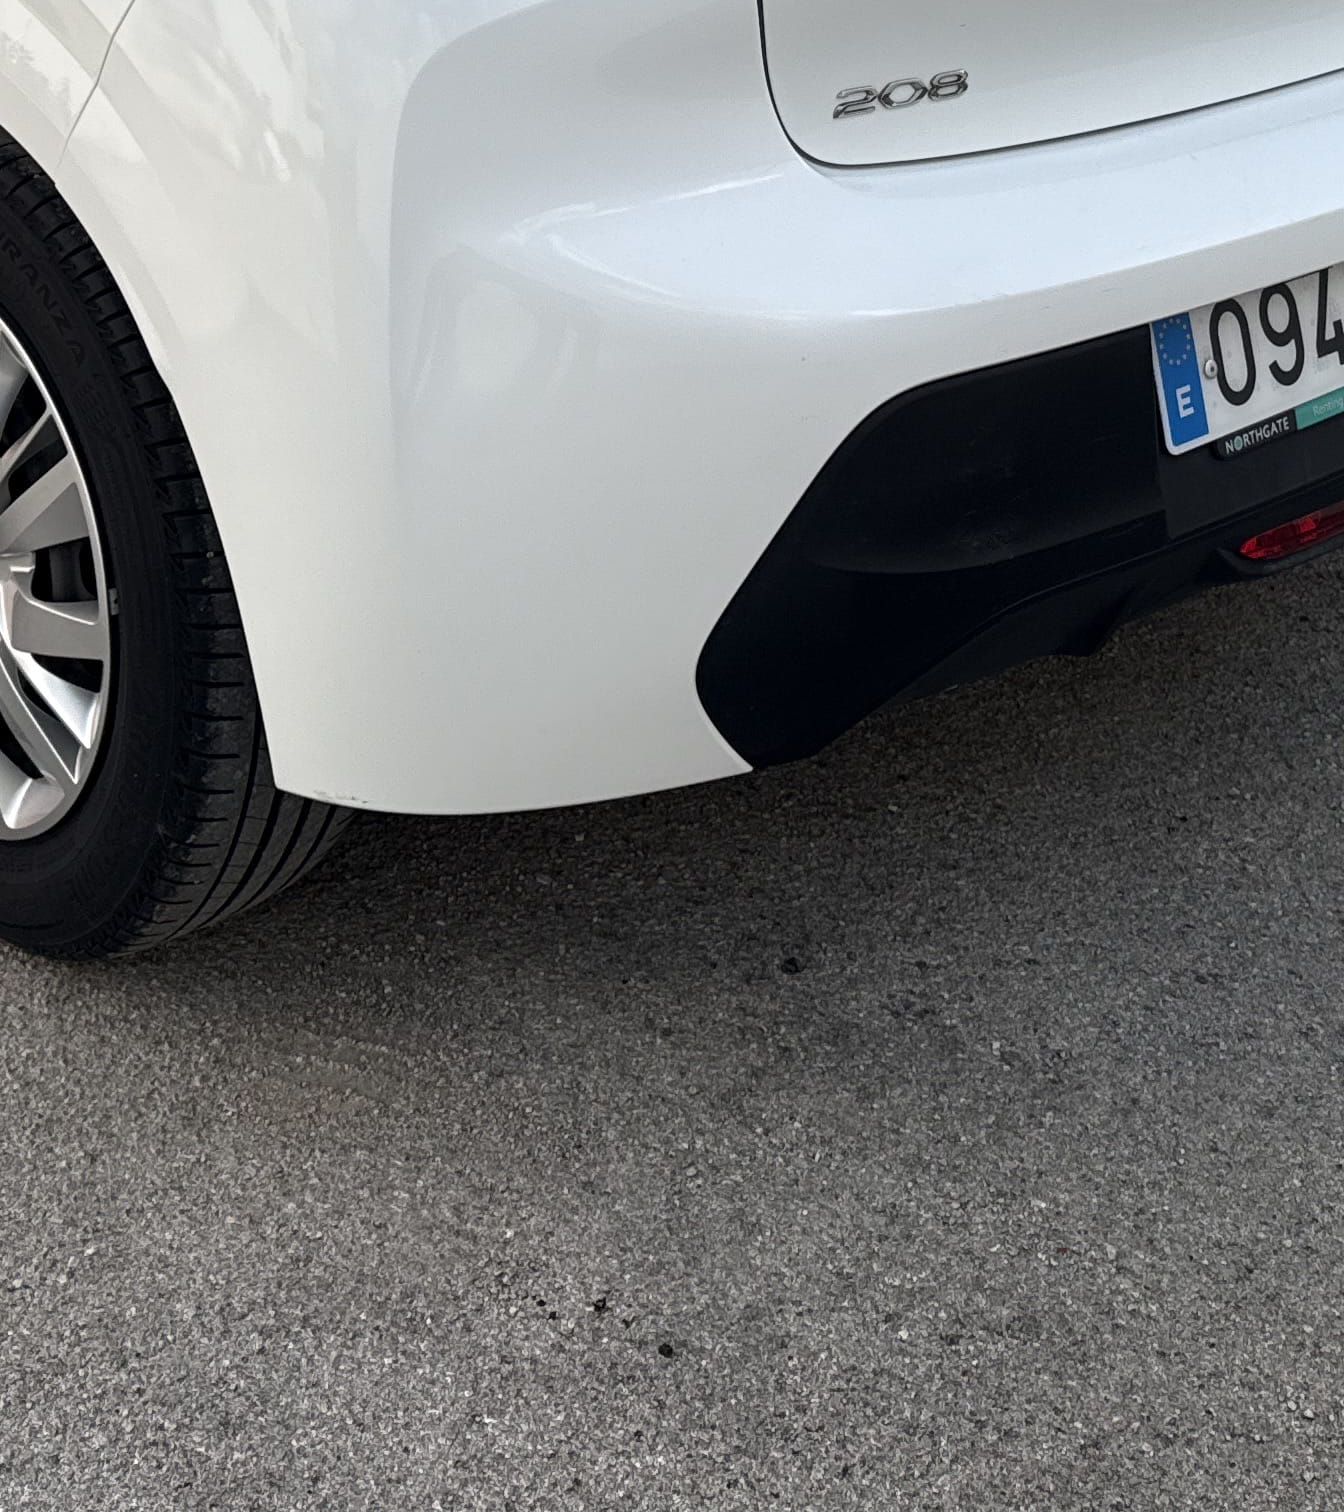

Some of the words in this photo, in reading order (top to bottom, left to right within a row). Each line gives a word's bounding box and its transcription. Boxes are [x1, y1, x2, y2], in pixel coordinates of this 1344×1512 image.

[833, 68, 968, 119] 208
[1175, 384, 1195, 419] E
[1224, 415, 1291, 456] NORTHGATE
